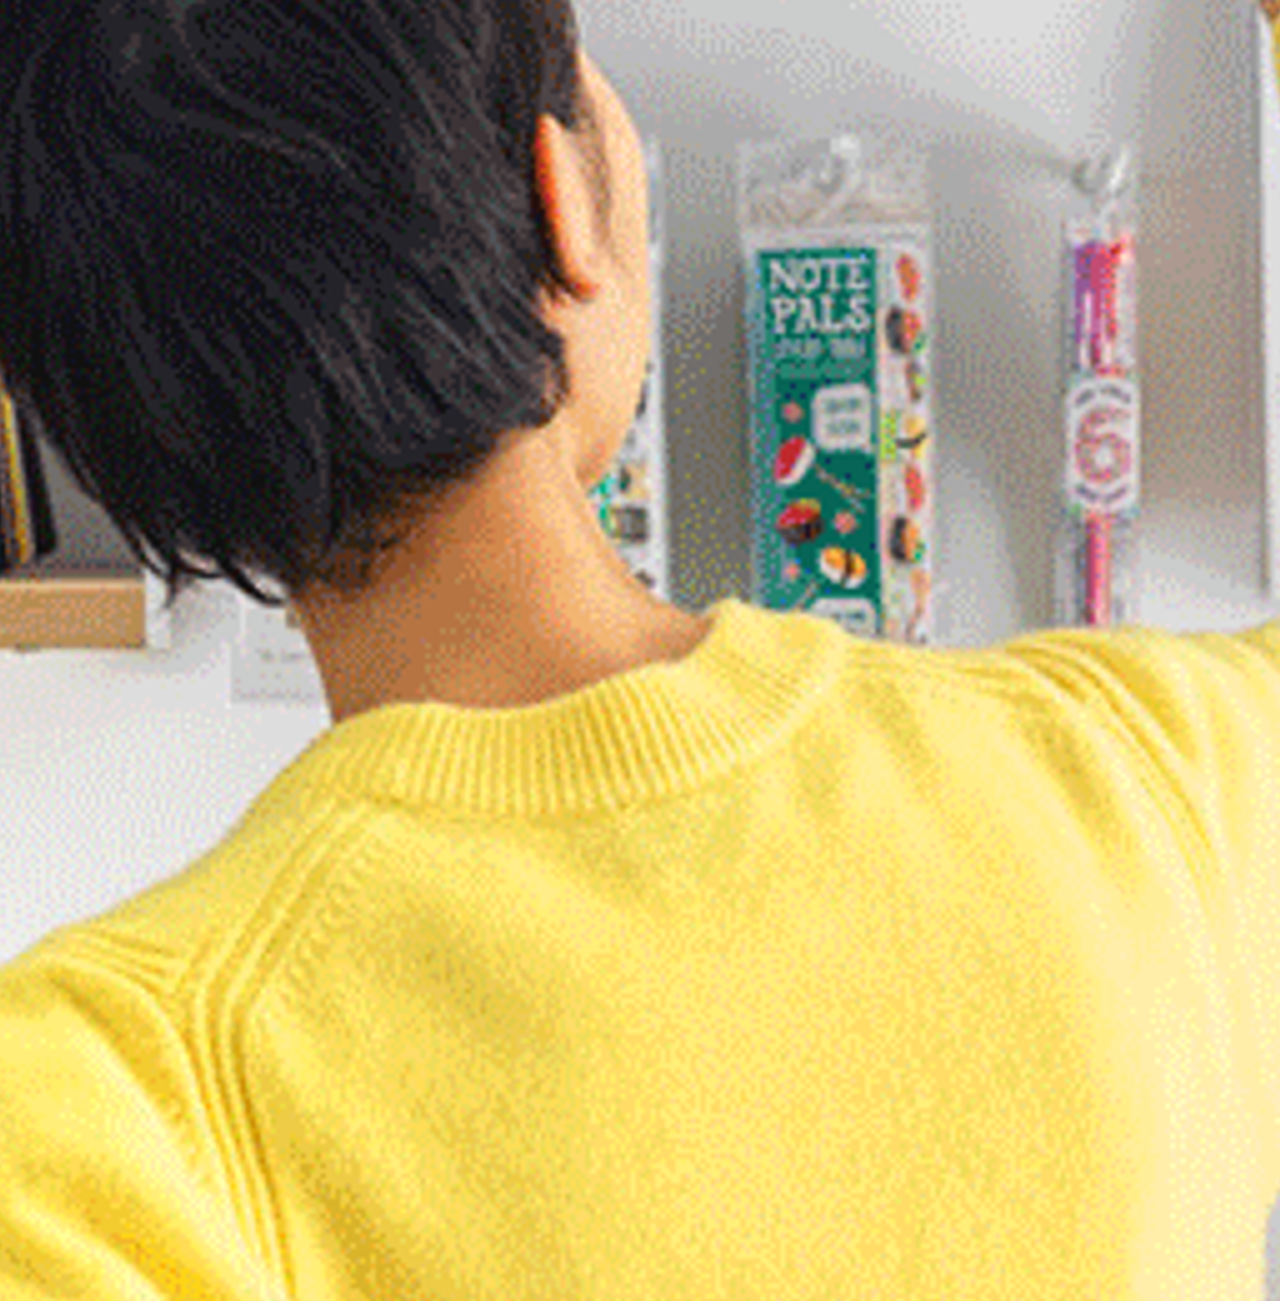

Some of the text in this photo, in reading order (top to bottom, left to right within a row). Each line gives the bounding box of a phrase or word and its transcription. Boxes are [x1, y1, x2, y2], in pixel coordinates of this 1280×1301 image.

[768, 258, 870, 292] NOTE
[770, 296, 871, 334] PALS
[1073, 405, 1133, 485] 6
